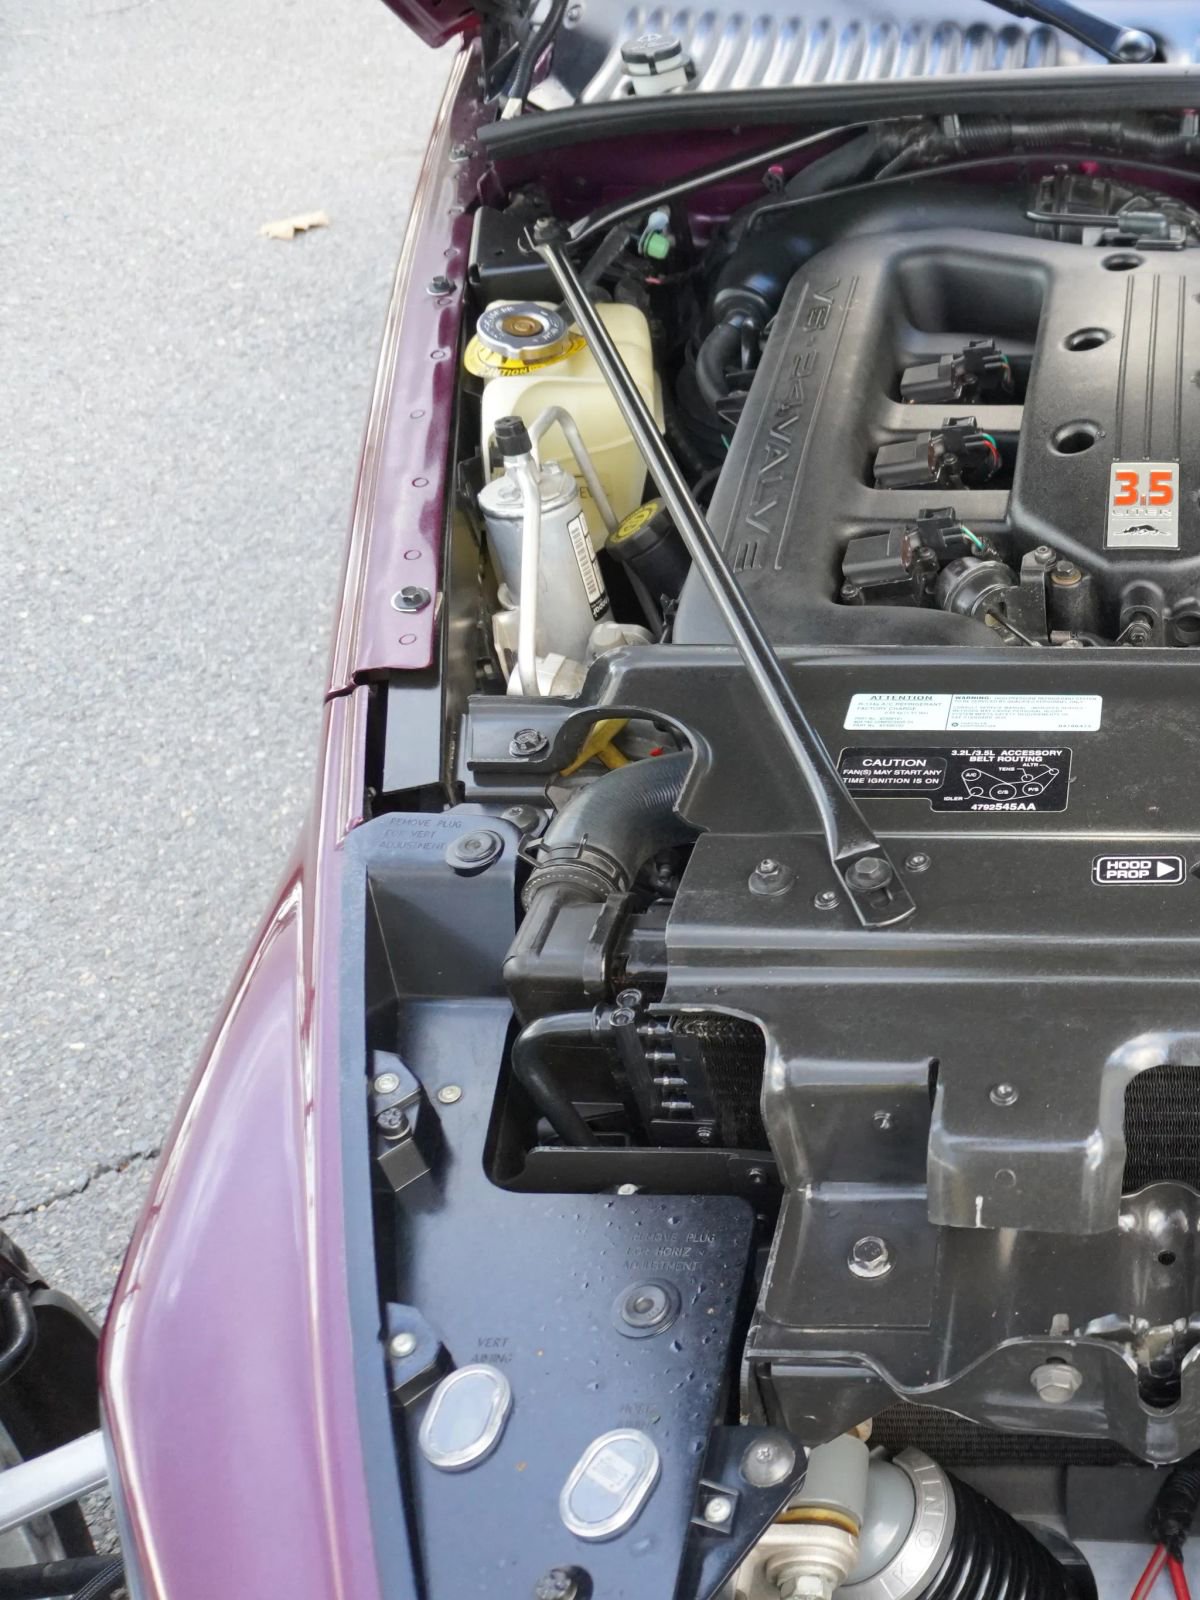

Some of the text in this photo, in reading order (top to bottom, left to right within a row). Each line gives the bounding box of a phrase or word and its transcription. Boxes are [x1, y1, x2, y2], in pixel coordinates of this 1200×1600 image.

[1113, 470, 1175, 507] 3.5
[1001, 749, 1063, 757] ACCESSORY
[862, 758, 928, 768] CAUTION
[842, 777, 940, 785] TIME IGNITION IS ON
[970, 803, 1037, 811] 4792545AA
[436, 820, 463, 829] PLUG
[1106, 860, 1152, 870] HOOD
[1106, 870, 1150, 879] PROP
[686, 1232, 716, 1243] PLUG
[656, 1246, 693, 1257] HORIZ
